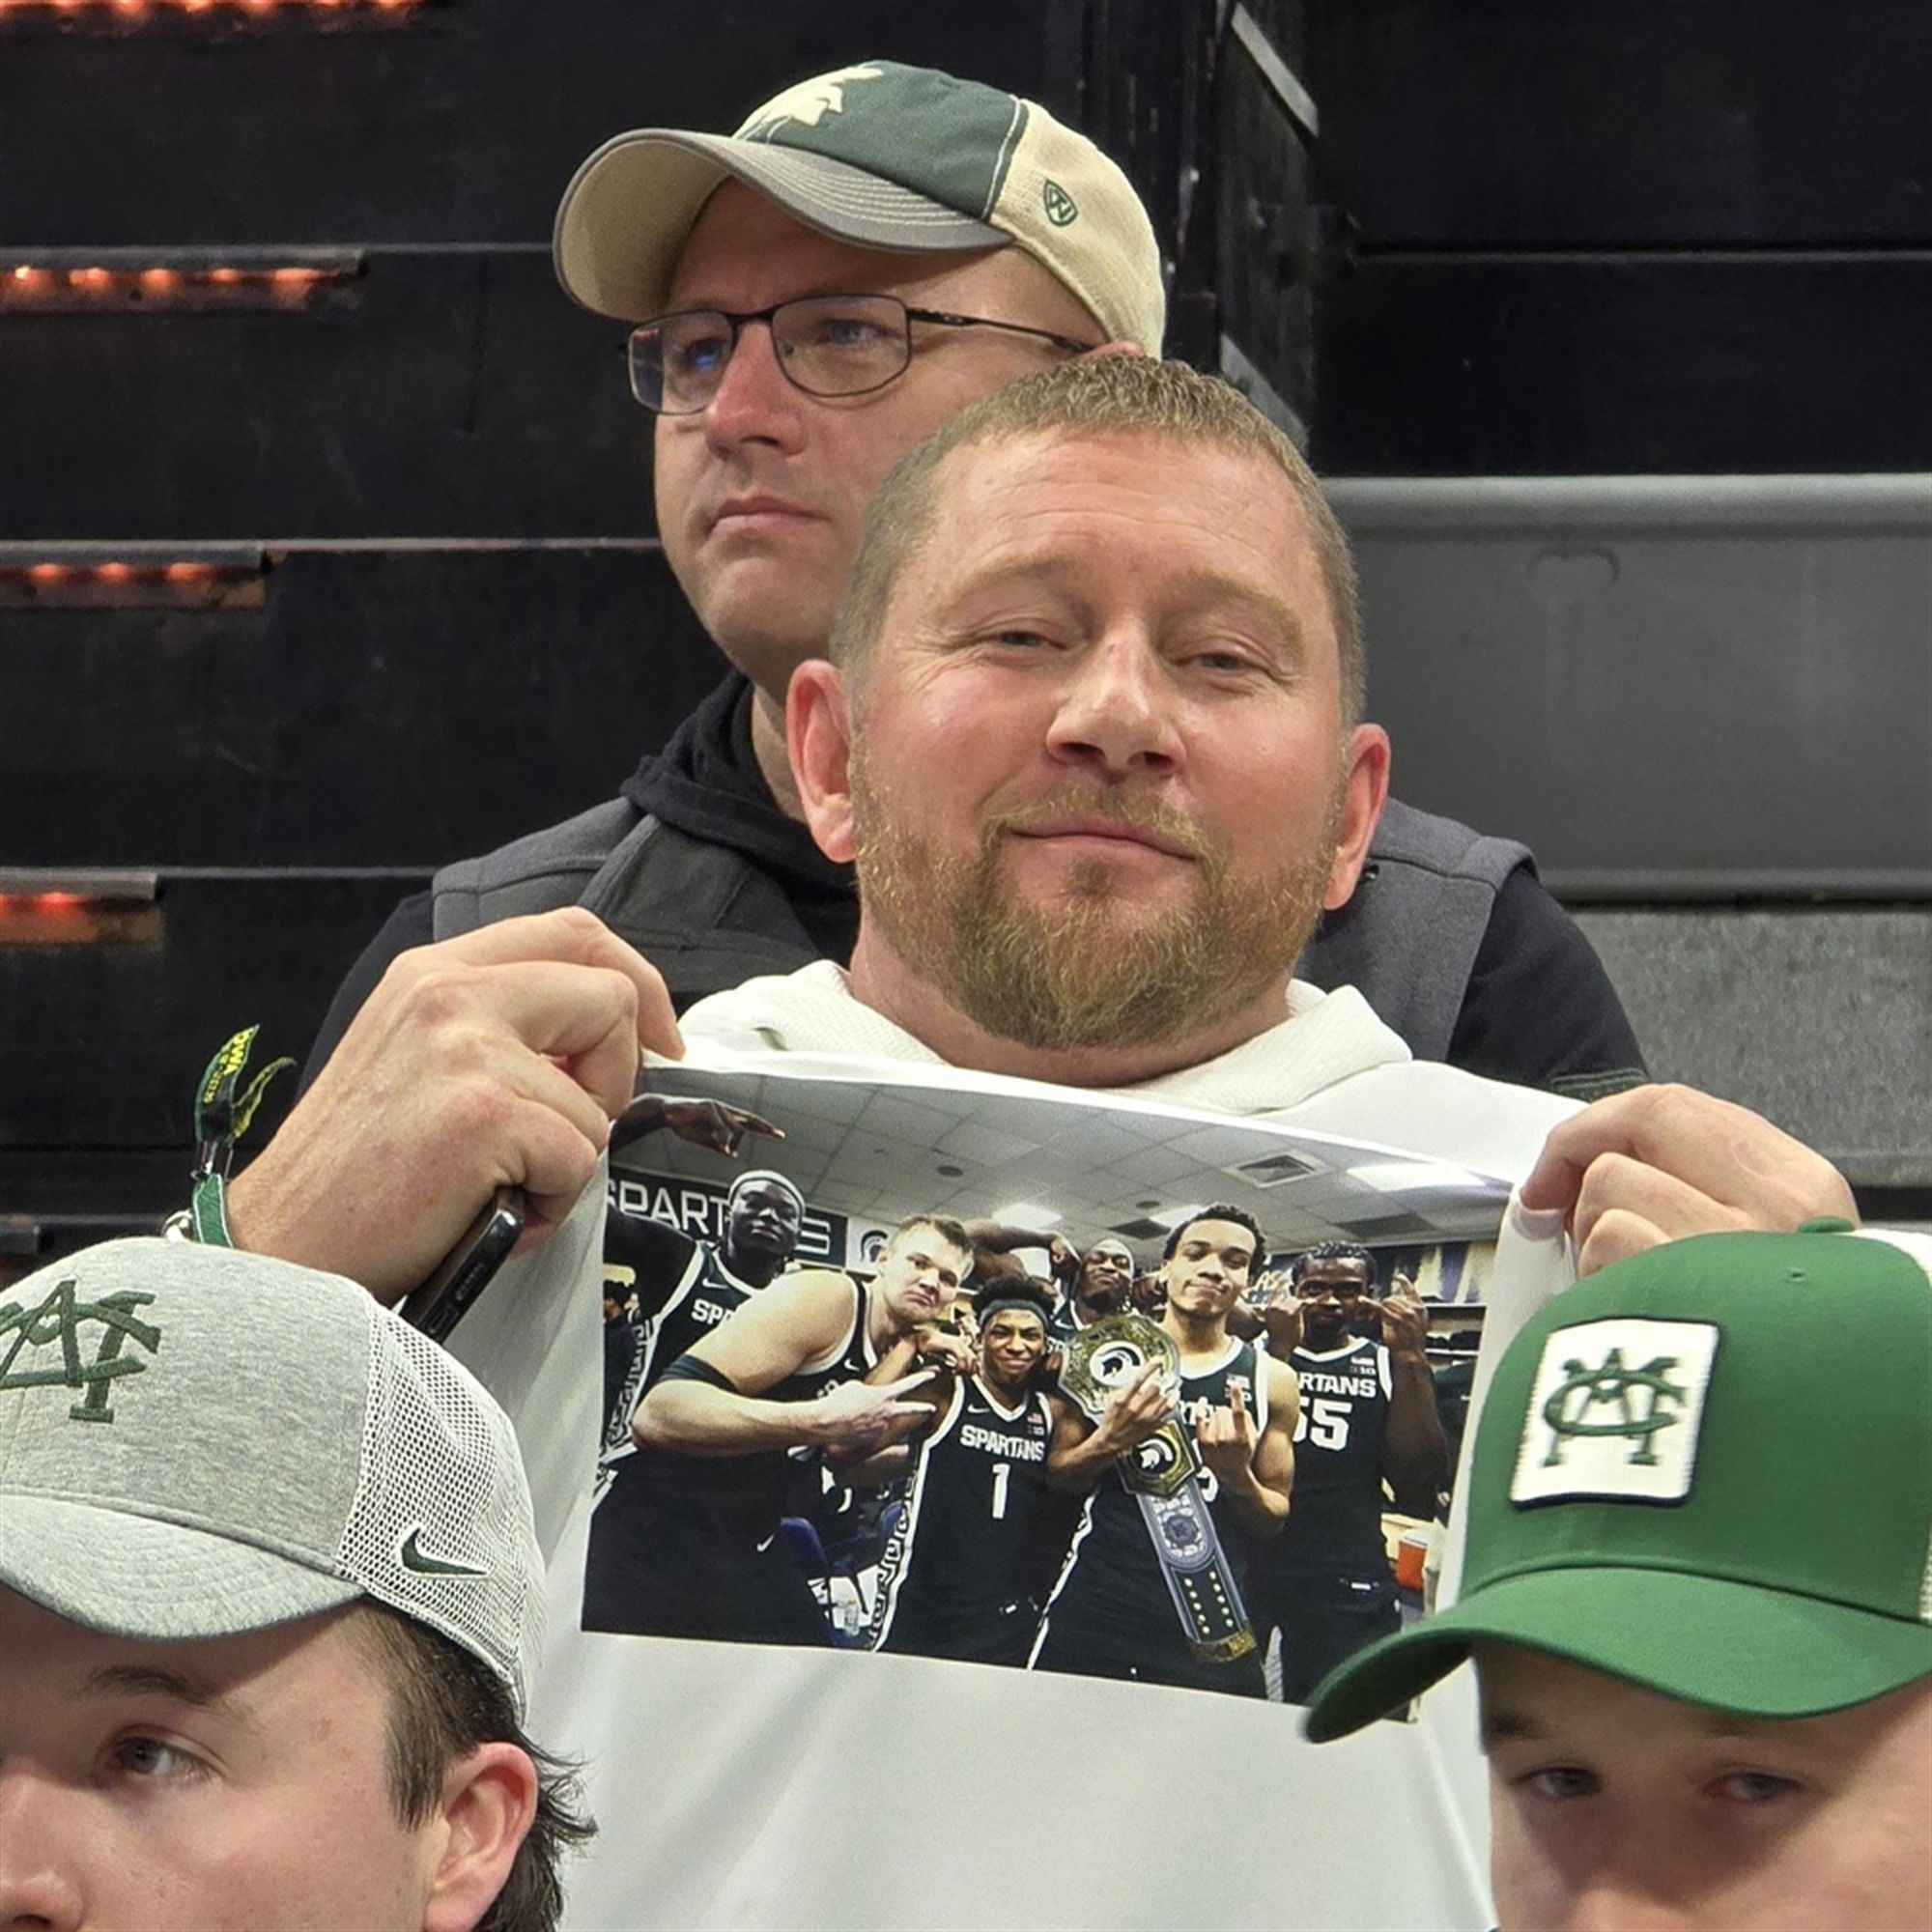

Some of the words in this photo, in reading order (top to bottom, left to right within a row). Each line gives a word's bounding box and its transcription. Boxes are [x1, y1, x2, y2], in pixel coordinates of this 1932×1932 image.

[608, 1178, 831, 1255] PARTS
[959, 1424, 1045, 1462] SPARTANS
[992, 1463, 1010, 1520] 1
